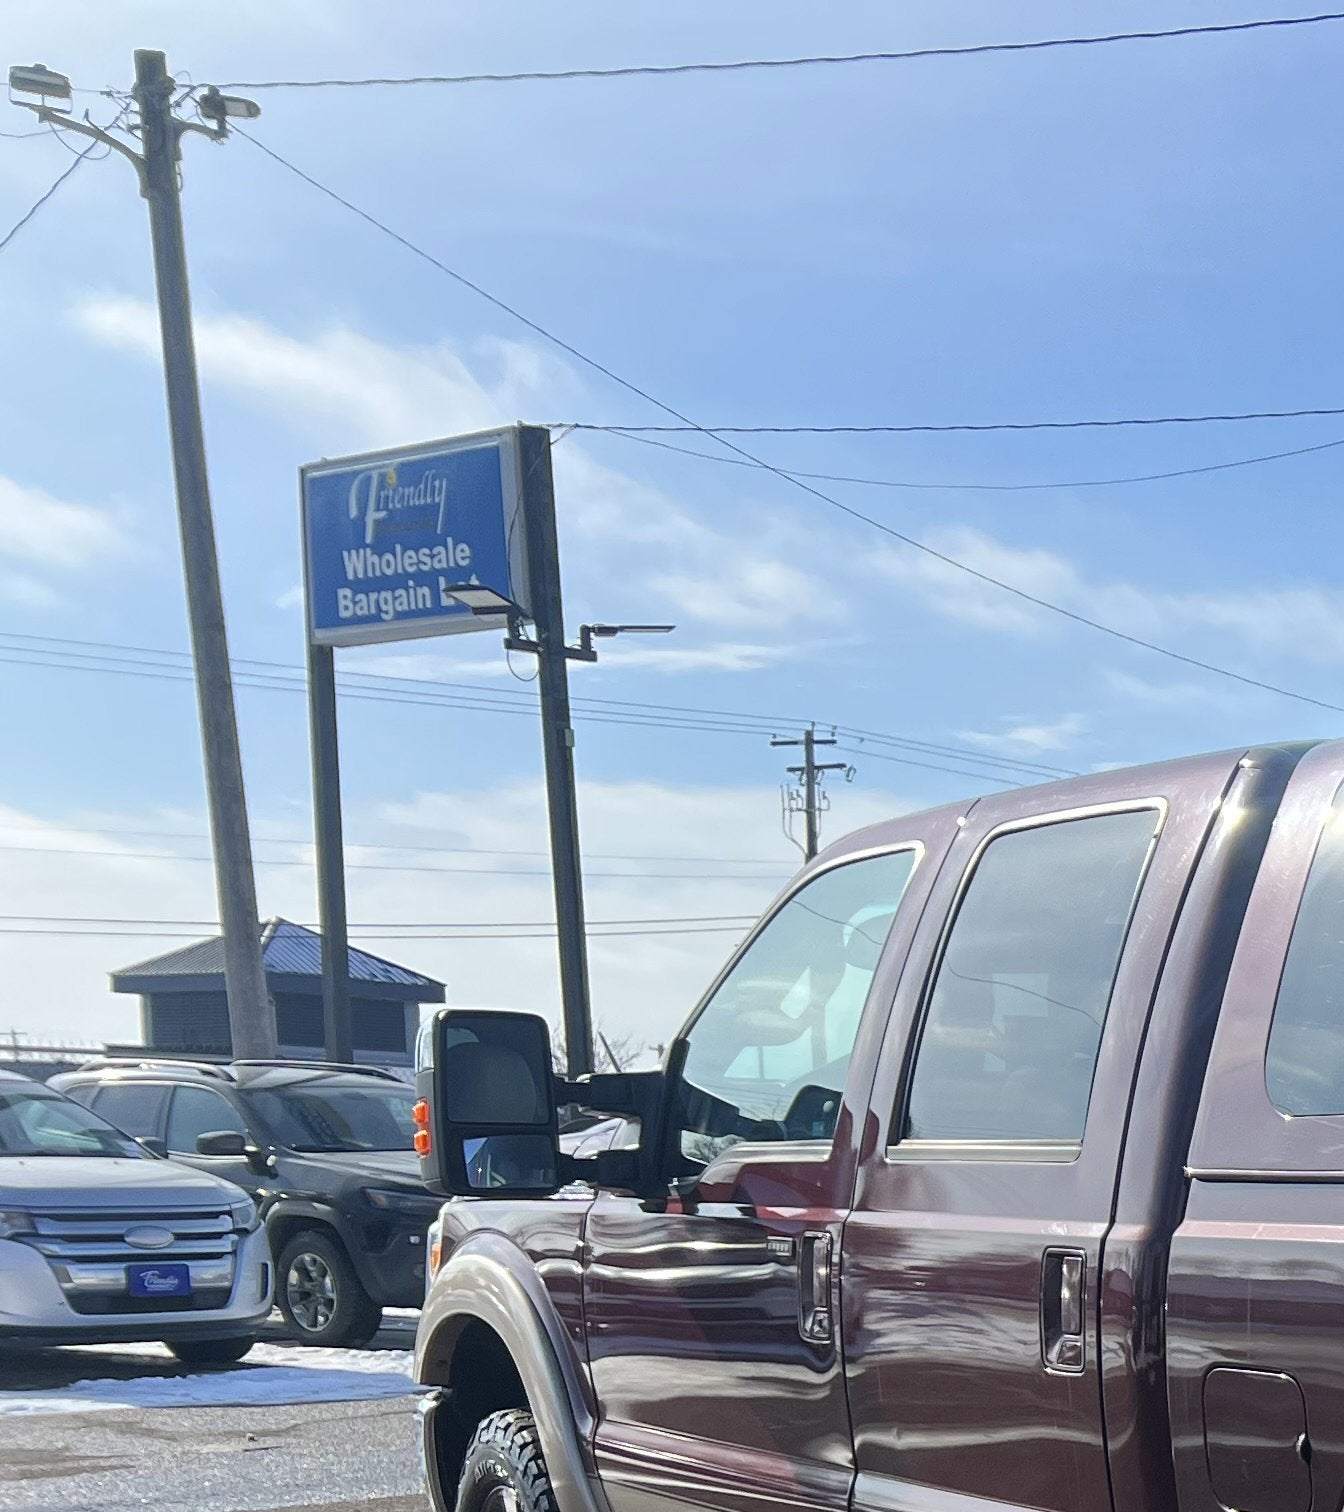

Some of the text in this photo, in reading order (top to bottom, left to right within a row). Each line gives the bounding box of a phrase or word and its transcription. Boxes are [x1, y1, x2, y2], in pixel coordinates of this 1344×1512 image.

[348, 467, 447, 544] Friendly
[342, 536, 471, 580] Wholesale
[337, 579, 432, 621] Bargain
